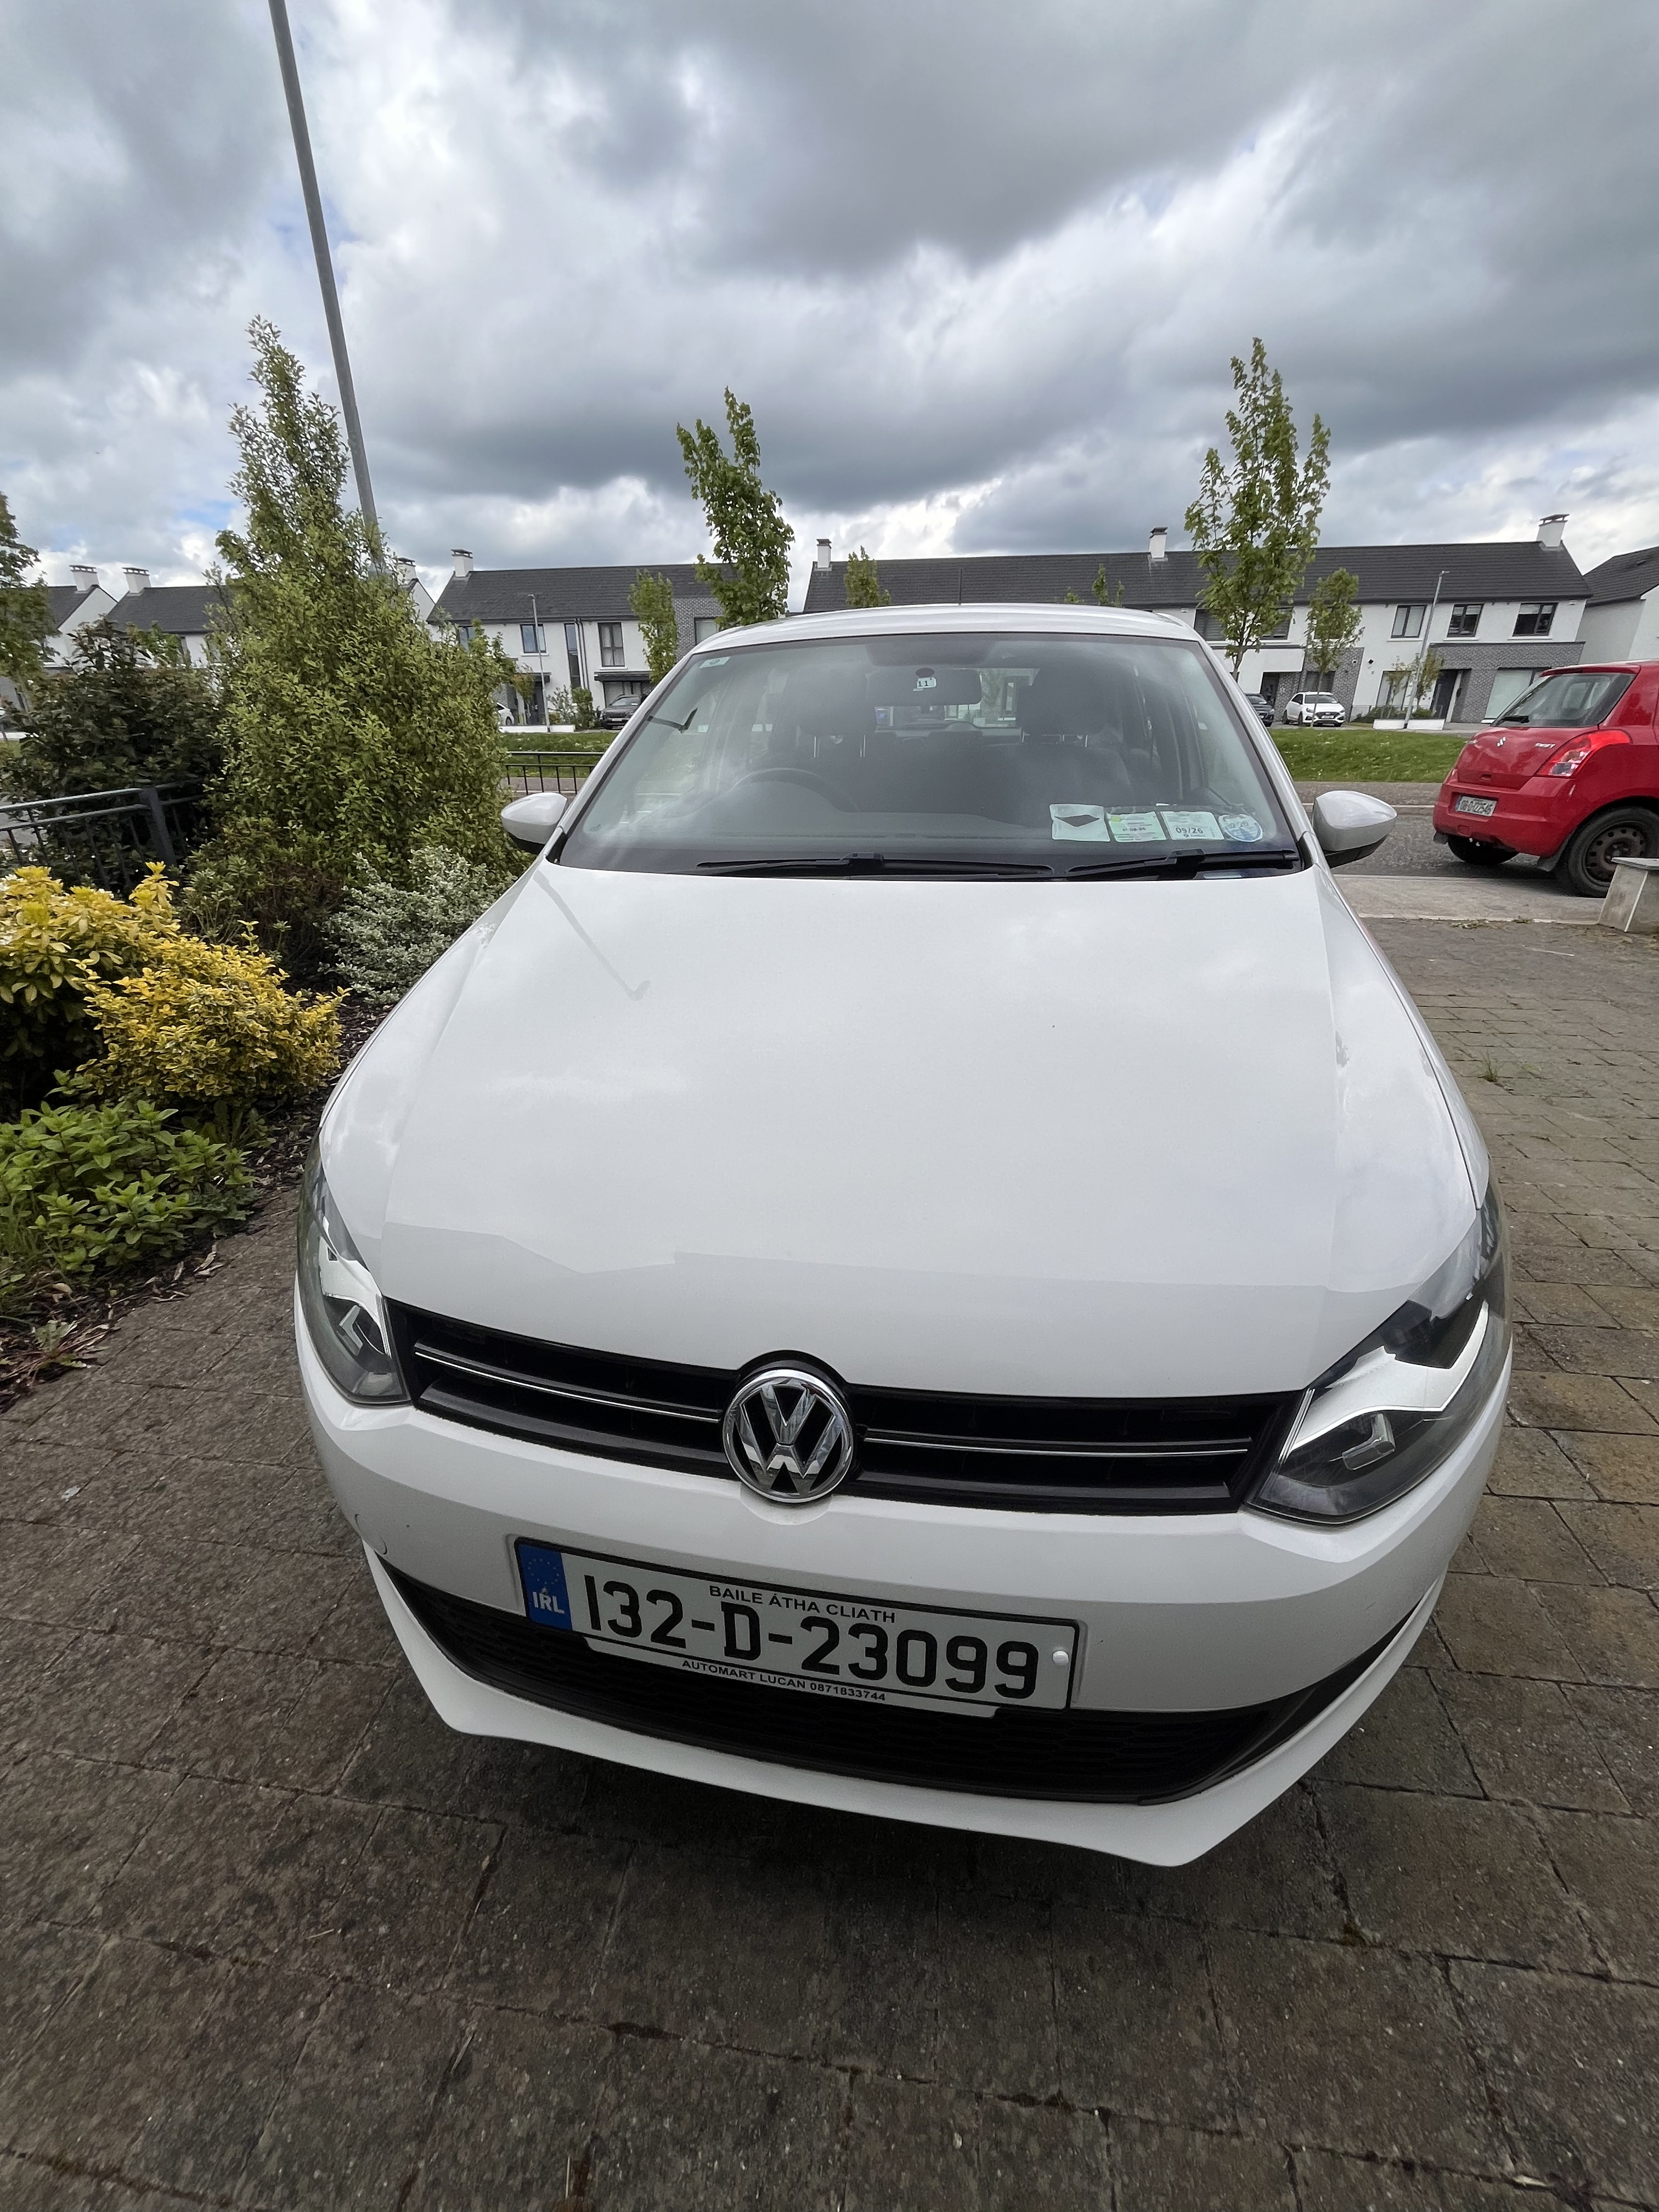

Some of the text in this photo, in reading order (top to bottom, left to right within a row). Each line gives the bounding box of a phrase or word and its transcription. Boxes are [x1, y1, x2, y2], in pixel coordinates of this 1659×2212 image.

[709, 1585, 895, 1624] BAILE ÁTHA CLIATH
[584, 1574, 1039, 1700] 132-D-23099
[682, 1660, 886, 1701] AUTOMART LUCAN 0871833744
